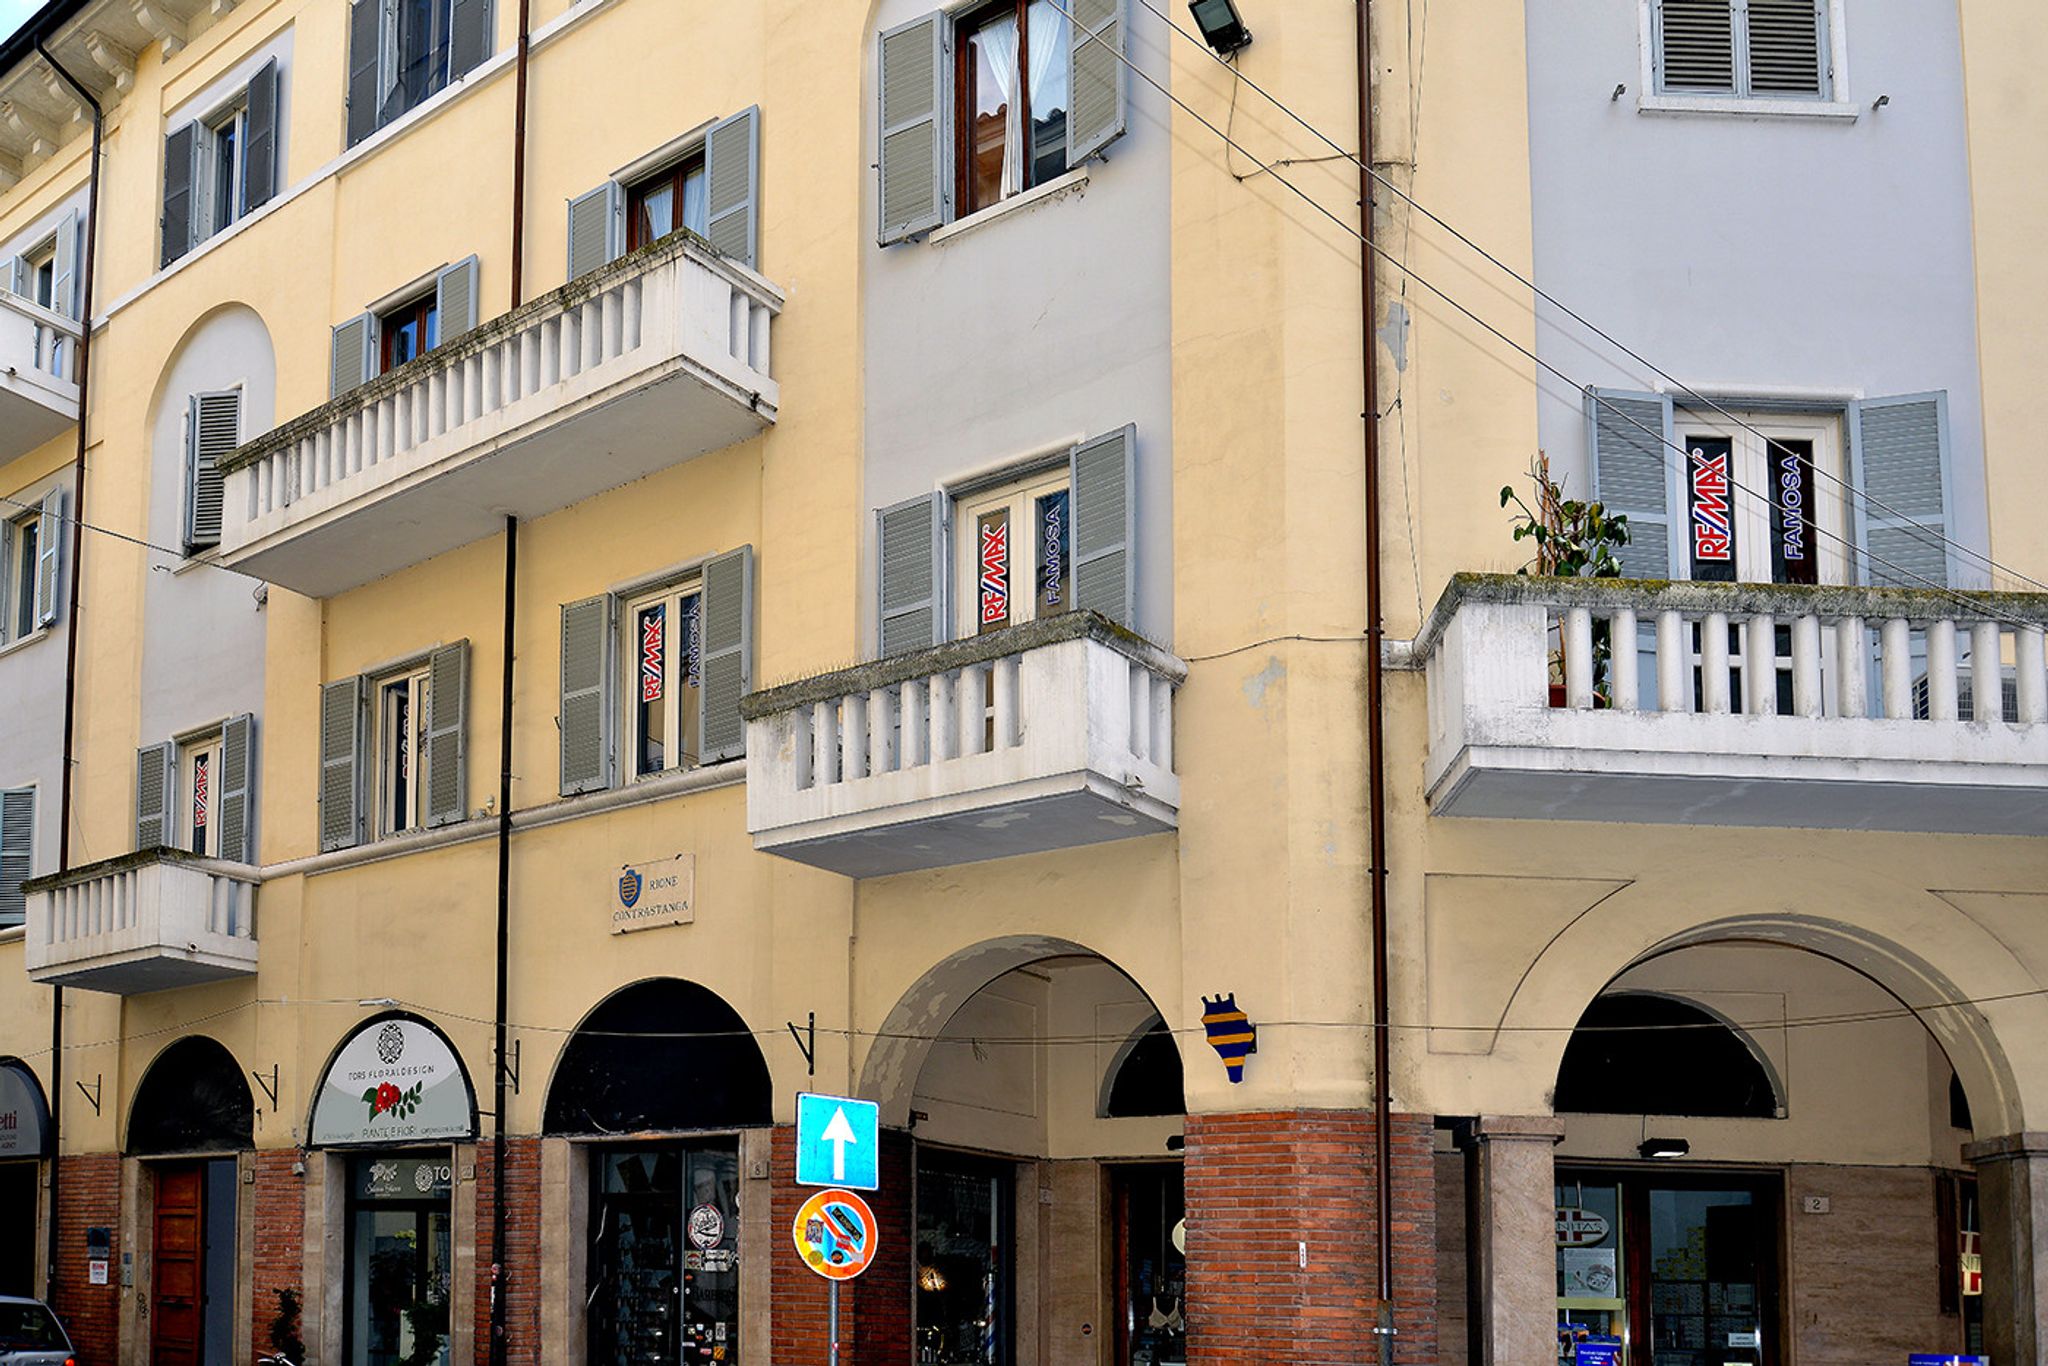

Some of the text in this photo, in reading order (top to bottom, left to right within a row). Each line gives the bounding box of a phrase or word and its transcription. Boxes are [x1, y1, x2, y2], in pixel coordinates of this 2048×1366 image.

[1693, 449, 1730, 560] RE/MAX
[1781, 453, 1803, 560] FAMOSA
[981, 521, 1007, 624] RE/MAX
[1045, 504, 1061, 606] FAMOSA
[643, 615, 662, 702] RE/MAX
[613, 901, 689, 922] CONTRASTANGA
[650, 875, 679, 891] RIONE
[348, 1071, 366, 1081] TORS
[1812, 1198, 1821, 1211] 2
